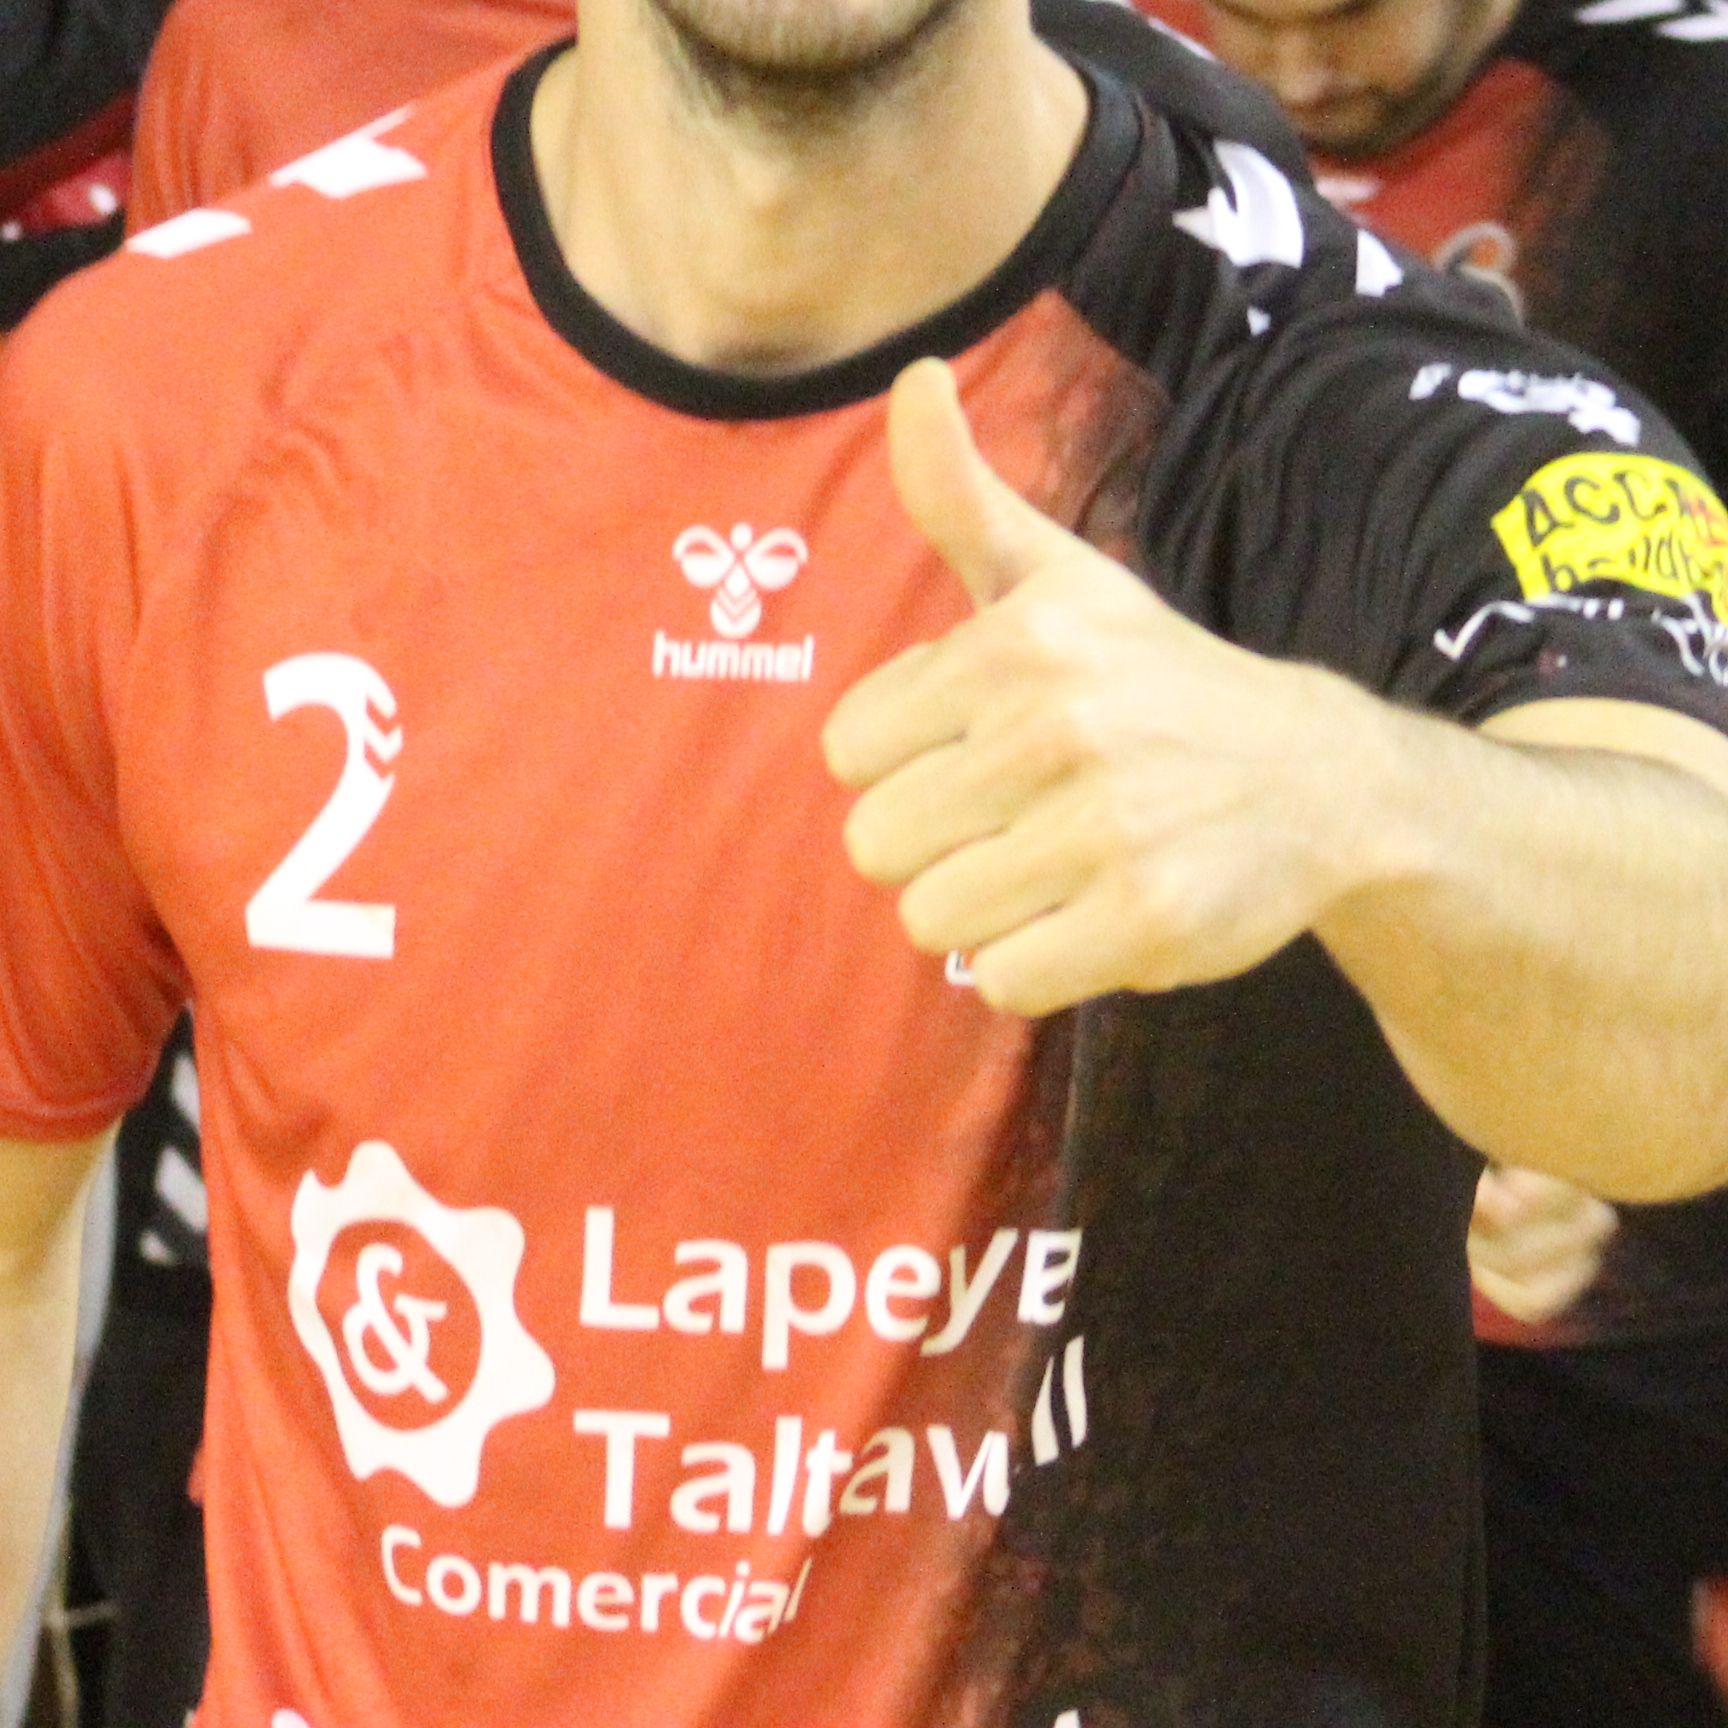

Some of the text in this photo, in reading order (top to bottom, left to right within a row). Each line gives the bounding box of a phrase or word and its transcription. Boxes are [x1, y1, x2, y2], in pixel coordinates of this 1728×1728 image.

[651, 629, 815, 683] hummel
[245, 651, 403, 959] 2
[341, 1242, 449, 1405] &
[379, 1523, 813, 1645] Comercial
